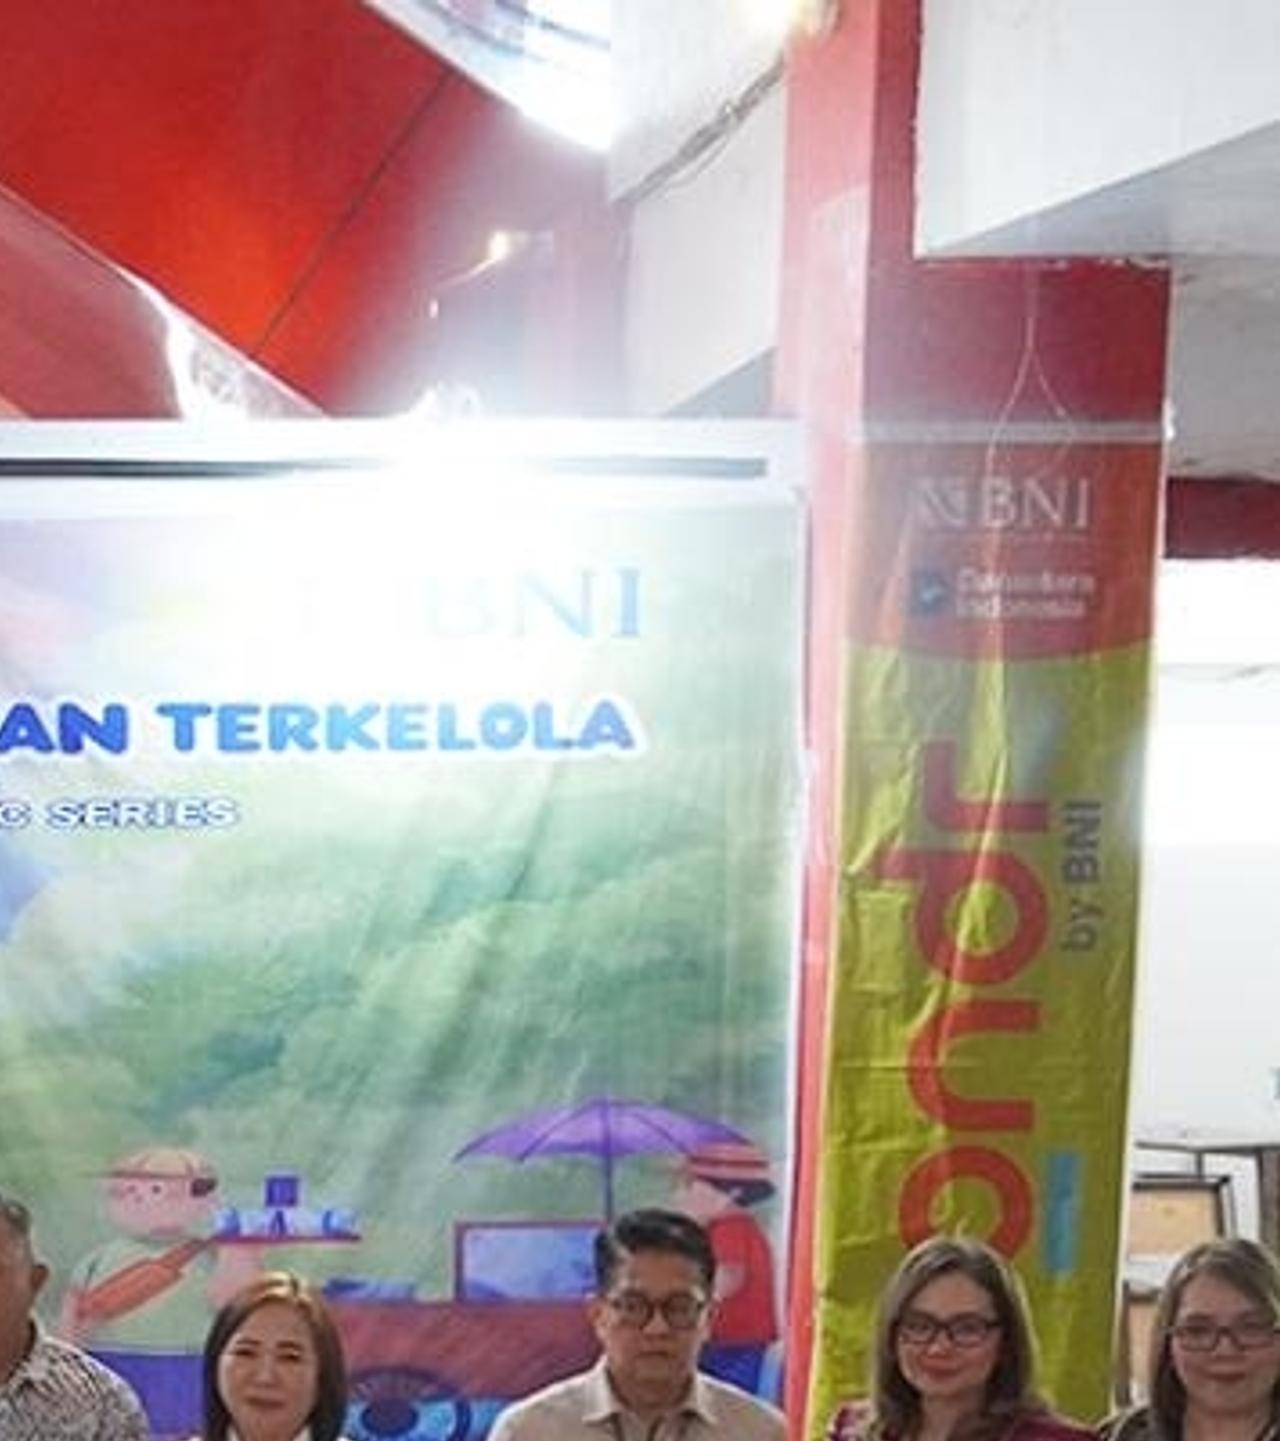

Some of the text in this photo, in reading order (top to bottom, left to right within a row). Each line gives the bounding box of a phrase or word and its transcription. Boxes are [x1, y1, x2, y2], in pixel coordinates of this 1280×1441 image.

[983, 478, 1088, 527] BNI
[430, 568, 641, 639] BNI
[156, 700, 636, 753] TERKELOLA
[47, 797, 240, 830] SERIES
[1061, 801, 1101, 953] by BNI
[876, 738, 1053, 1262] ondr
